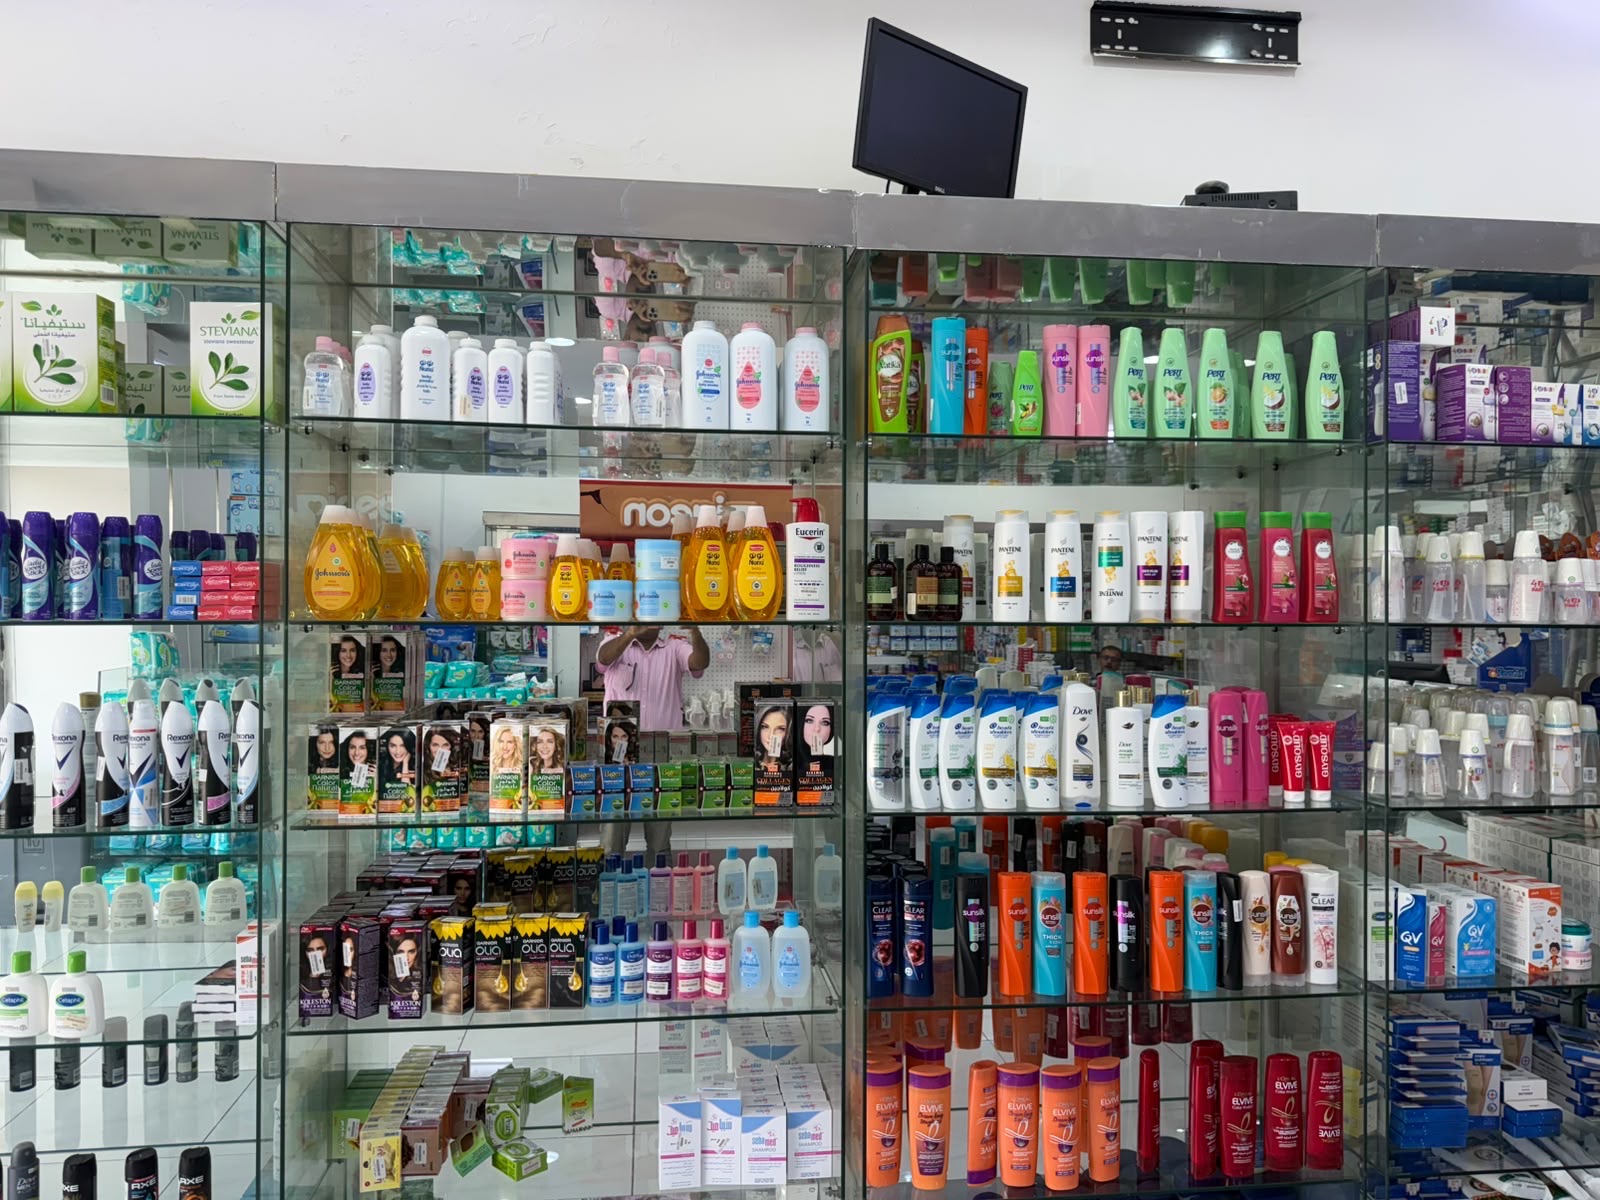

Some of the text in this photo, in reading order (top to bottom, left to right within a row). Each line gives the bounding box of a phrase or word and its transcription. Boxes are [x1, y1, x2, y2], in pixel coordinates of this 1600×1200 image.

[200, 326, 259, 337] STEVIANA
[795, 527, 825, 537] Eucerin
[1072, 706, 1093, 715] Dove
[1271, 731, 1279, 773] GLYSOLID
[1293, 735, 1303, 778] GLYSOLID
[1320, 735, 1329, 778] GLYSOLID
[1310, 896, 1335, 905] CLEAR
[904, 905, 925, 914] CLEAR
[963, 908, 985, 916] sunsilk
[1468, 925, 1486, 938] QV
[1400, 931, 1423, 945] QV
[1431, 936, 1444, 946] QV
[58, 996, 81, 1004] Cetaphil
[1275, 1081, 1298, 1089] ELVIVE
[1232, 1096, 1254, 1105] ELVIVE
[876, 1102, 899, 1111] ELVIVE
[919, 1104, 944, 1113] ELVIVE
[1052, 1107, 1077, 1116] ELVIVE
[798, 1131, 824, 1141] sebamed
[752, 1137, 778, 1146] sebamed
[131, 1177, 158, 1190] AXE
[179, 1175, 204, 1185] AXE
[63, 1184, 79, 1192] XE
